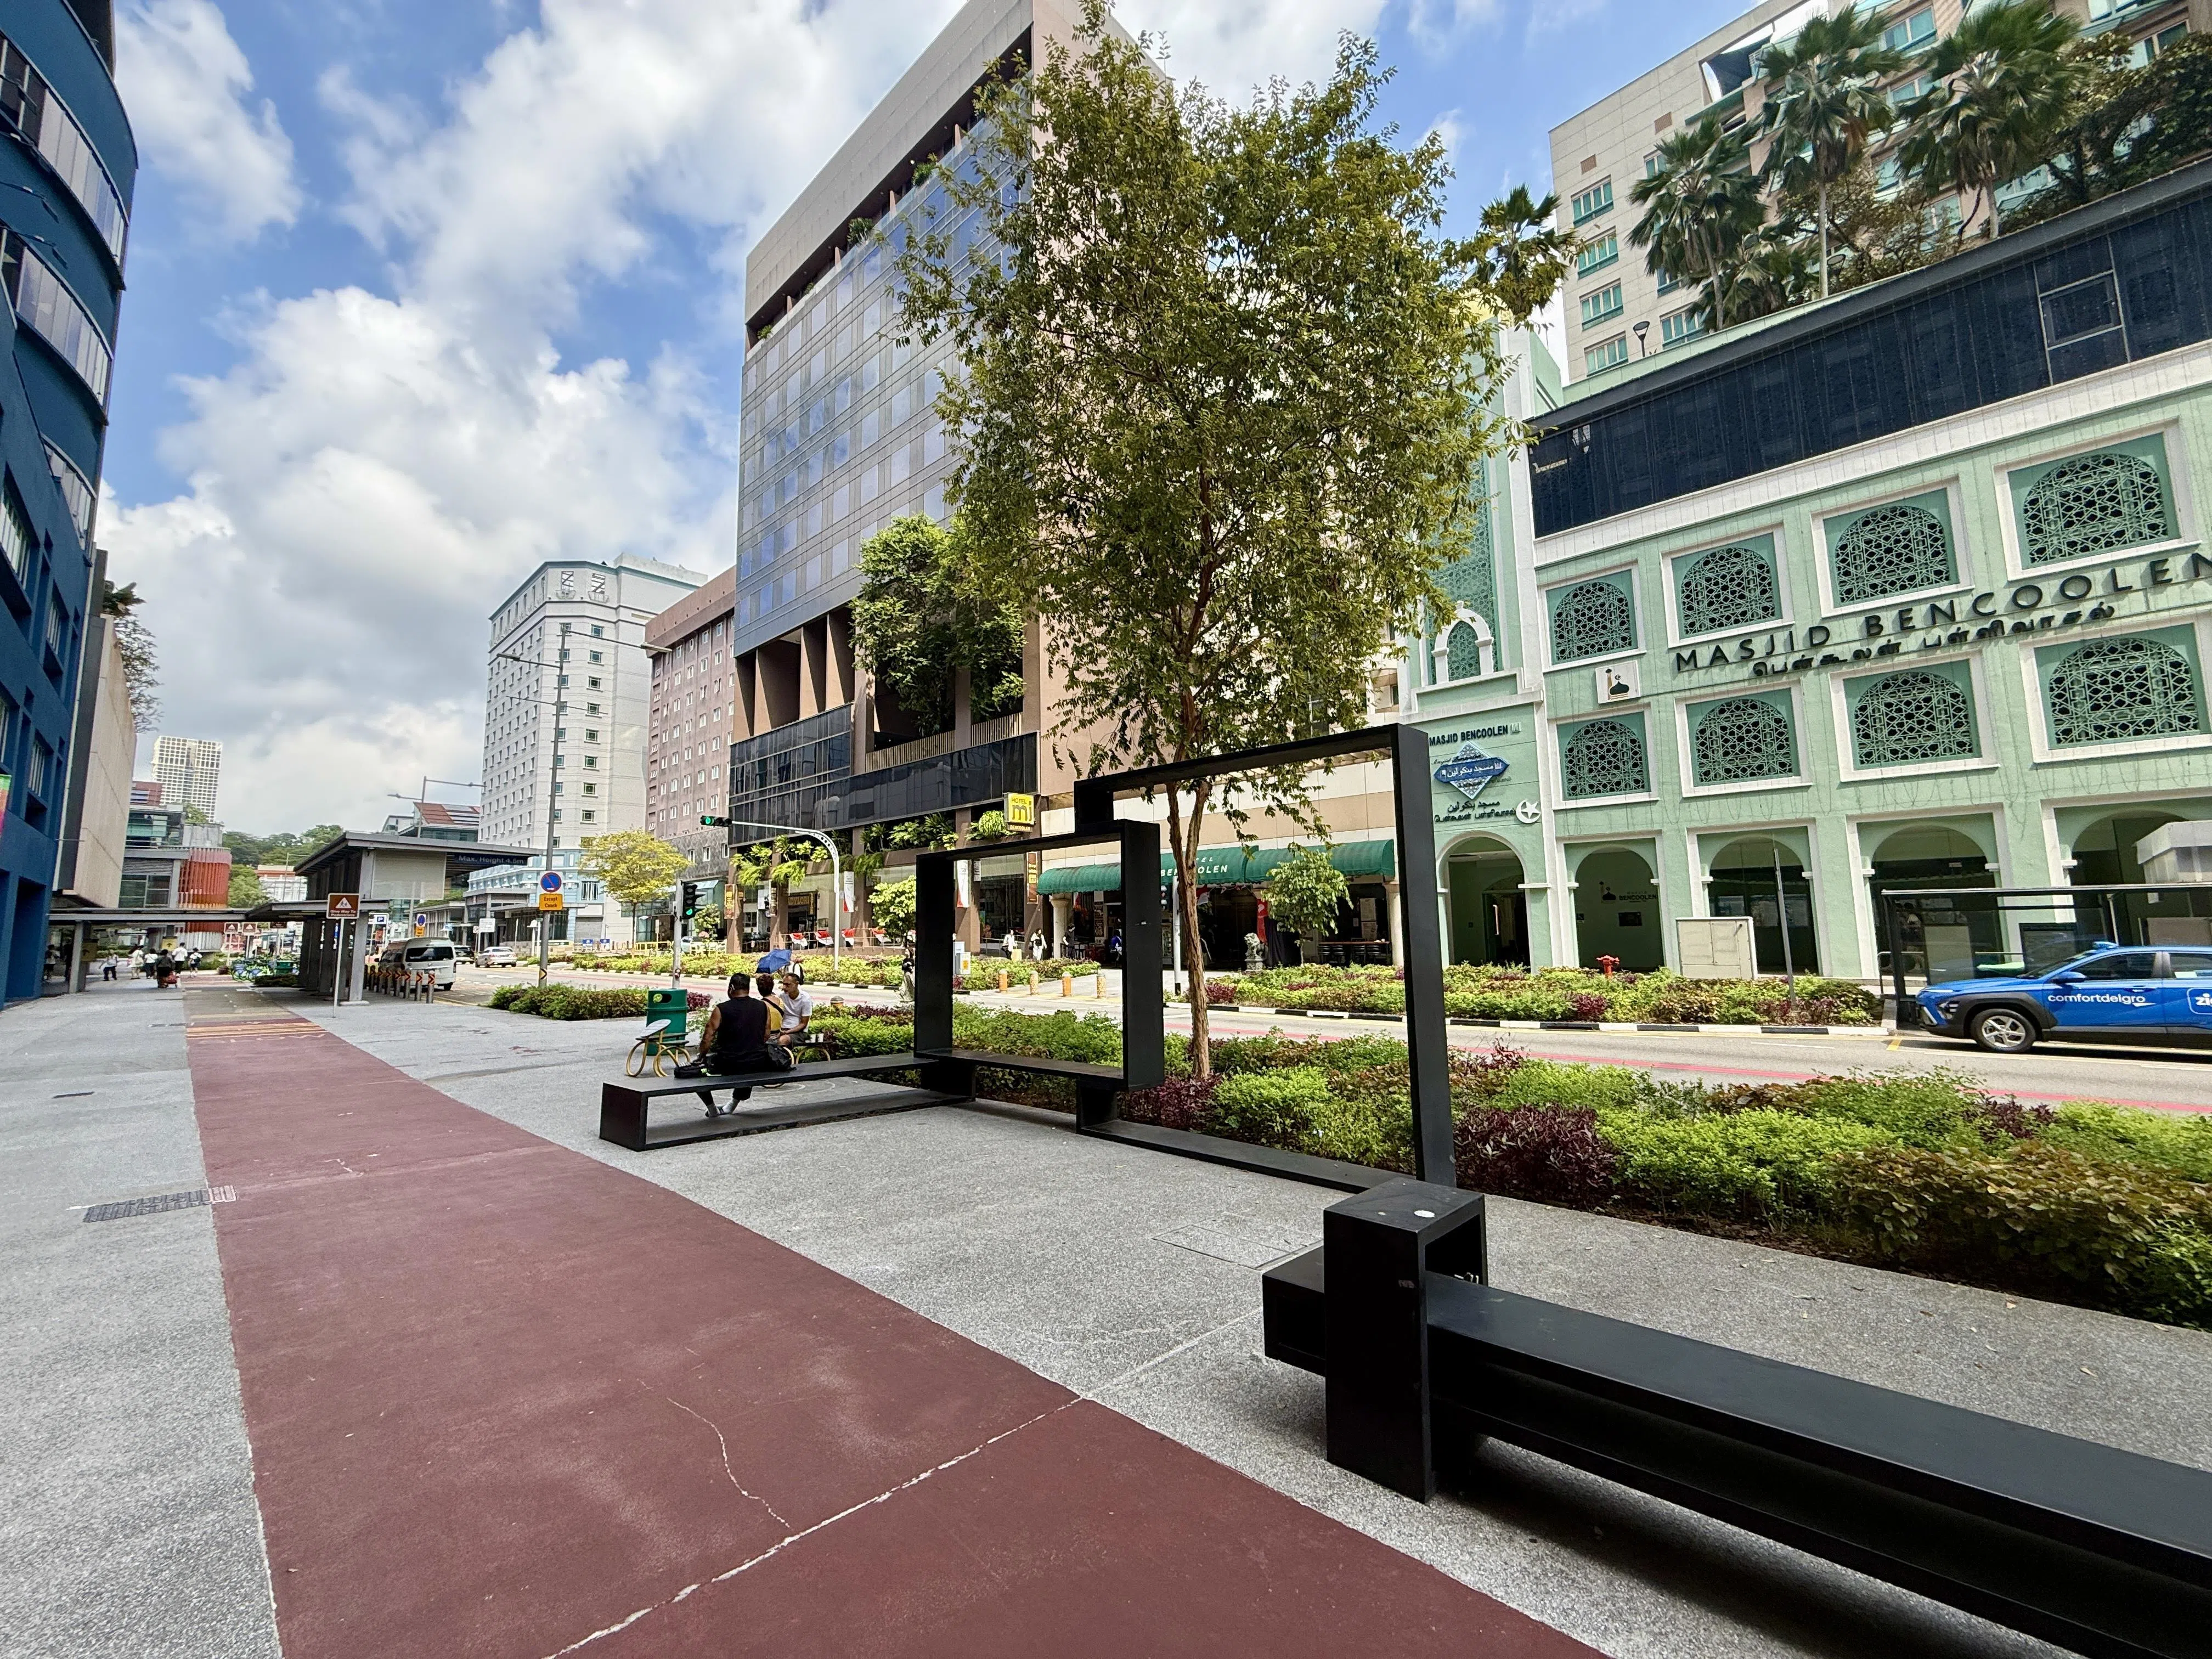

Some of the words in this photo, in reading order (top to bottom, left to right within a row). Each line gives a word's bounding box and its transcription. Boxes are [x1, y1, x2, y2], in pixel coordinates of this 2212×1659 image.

[1676, 625, 1830, 672] MASJID
[1865, 552, 2212, 636] BENCOOLEN
[1429, 733, 1458, 746] MASJID
[1461, 725, 1508, 741] BENCOOLEN
[1012, 801, 1032, 822] mi
[1160, 865, 1228, 877] BENOLEN
[2047, 994, 2146, 1005] comfortdelgro
[2196, 993, 2212, 1007] zi
